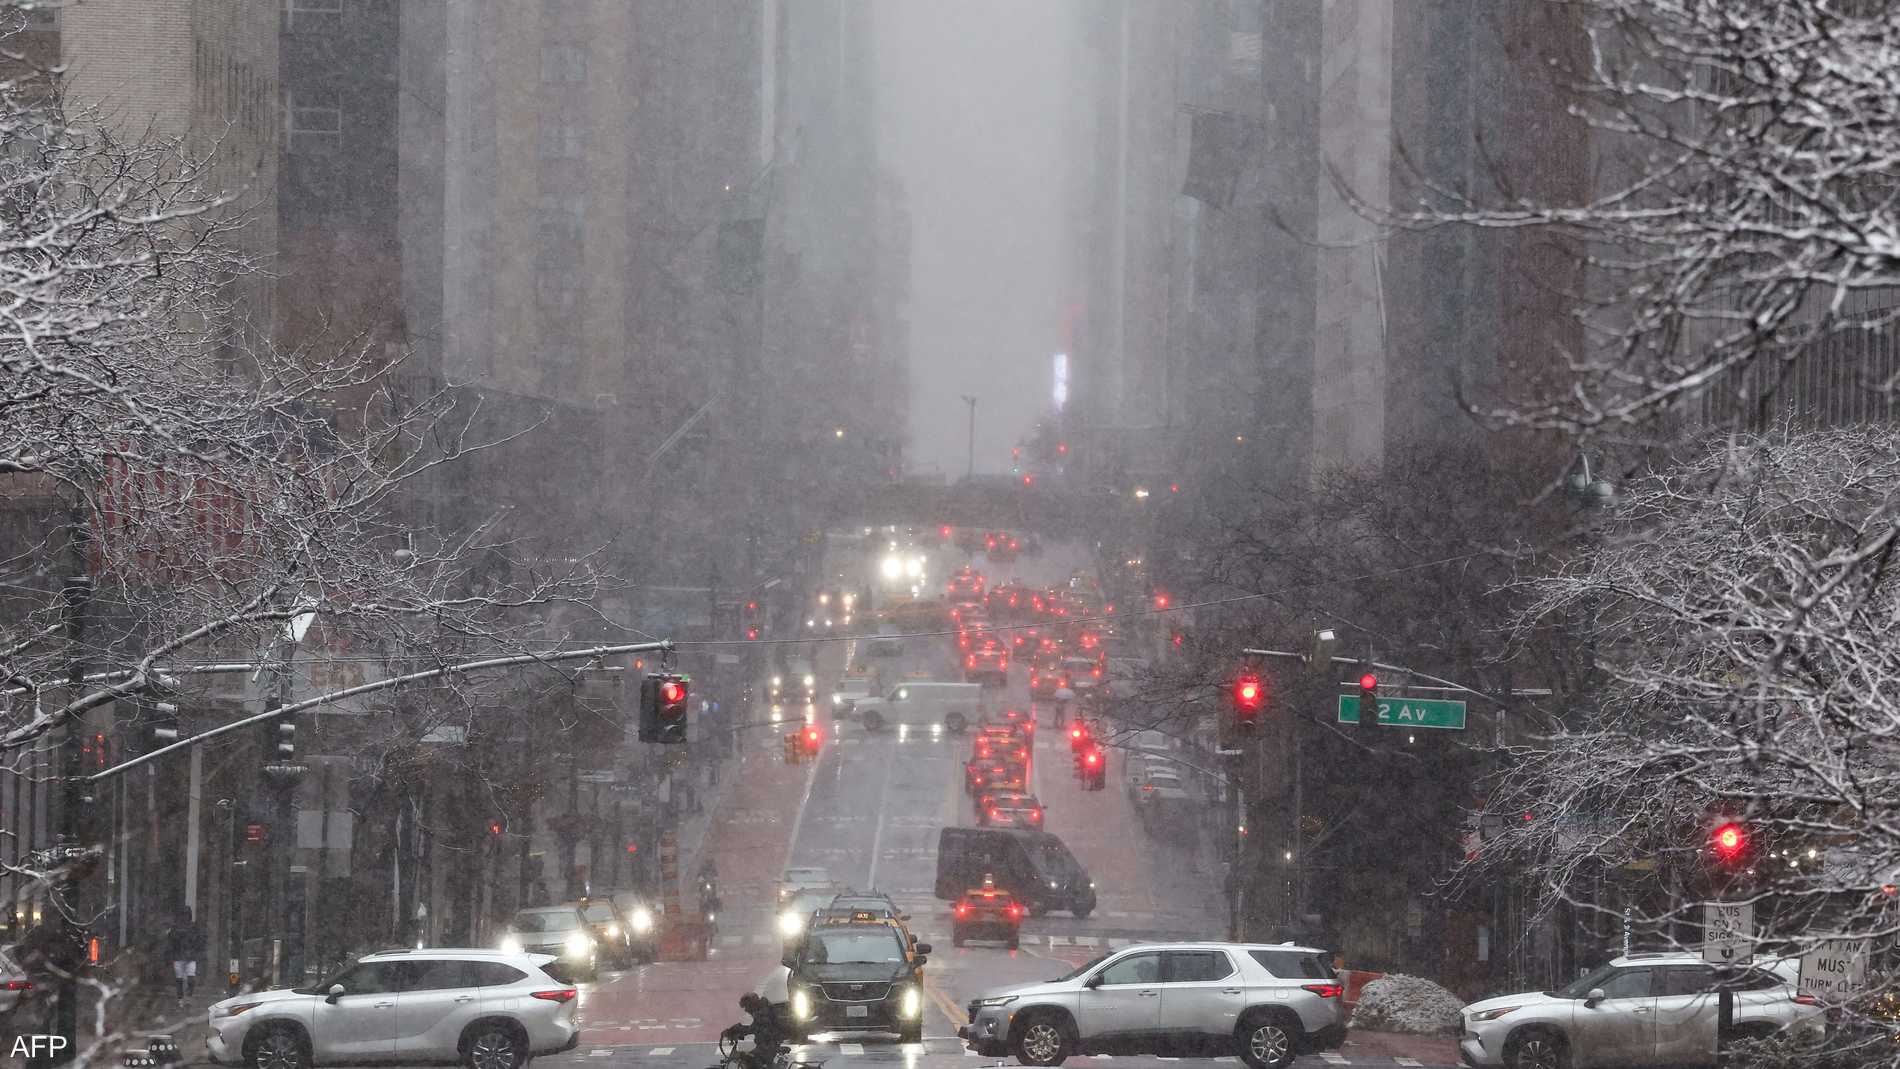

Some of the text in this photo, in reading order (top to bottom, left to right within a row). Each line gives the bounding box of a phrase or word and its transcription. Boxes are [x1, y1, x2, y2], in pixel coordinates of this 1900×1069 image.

[1378, 704, 1427, 721] 2 Av
[1804, 977, 1832, 989] TURN
